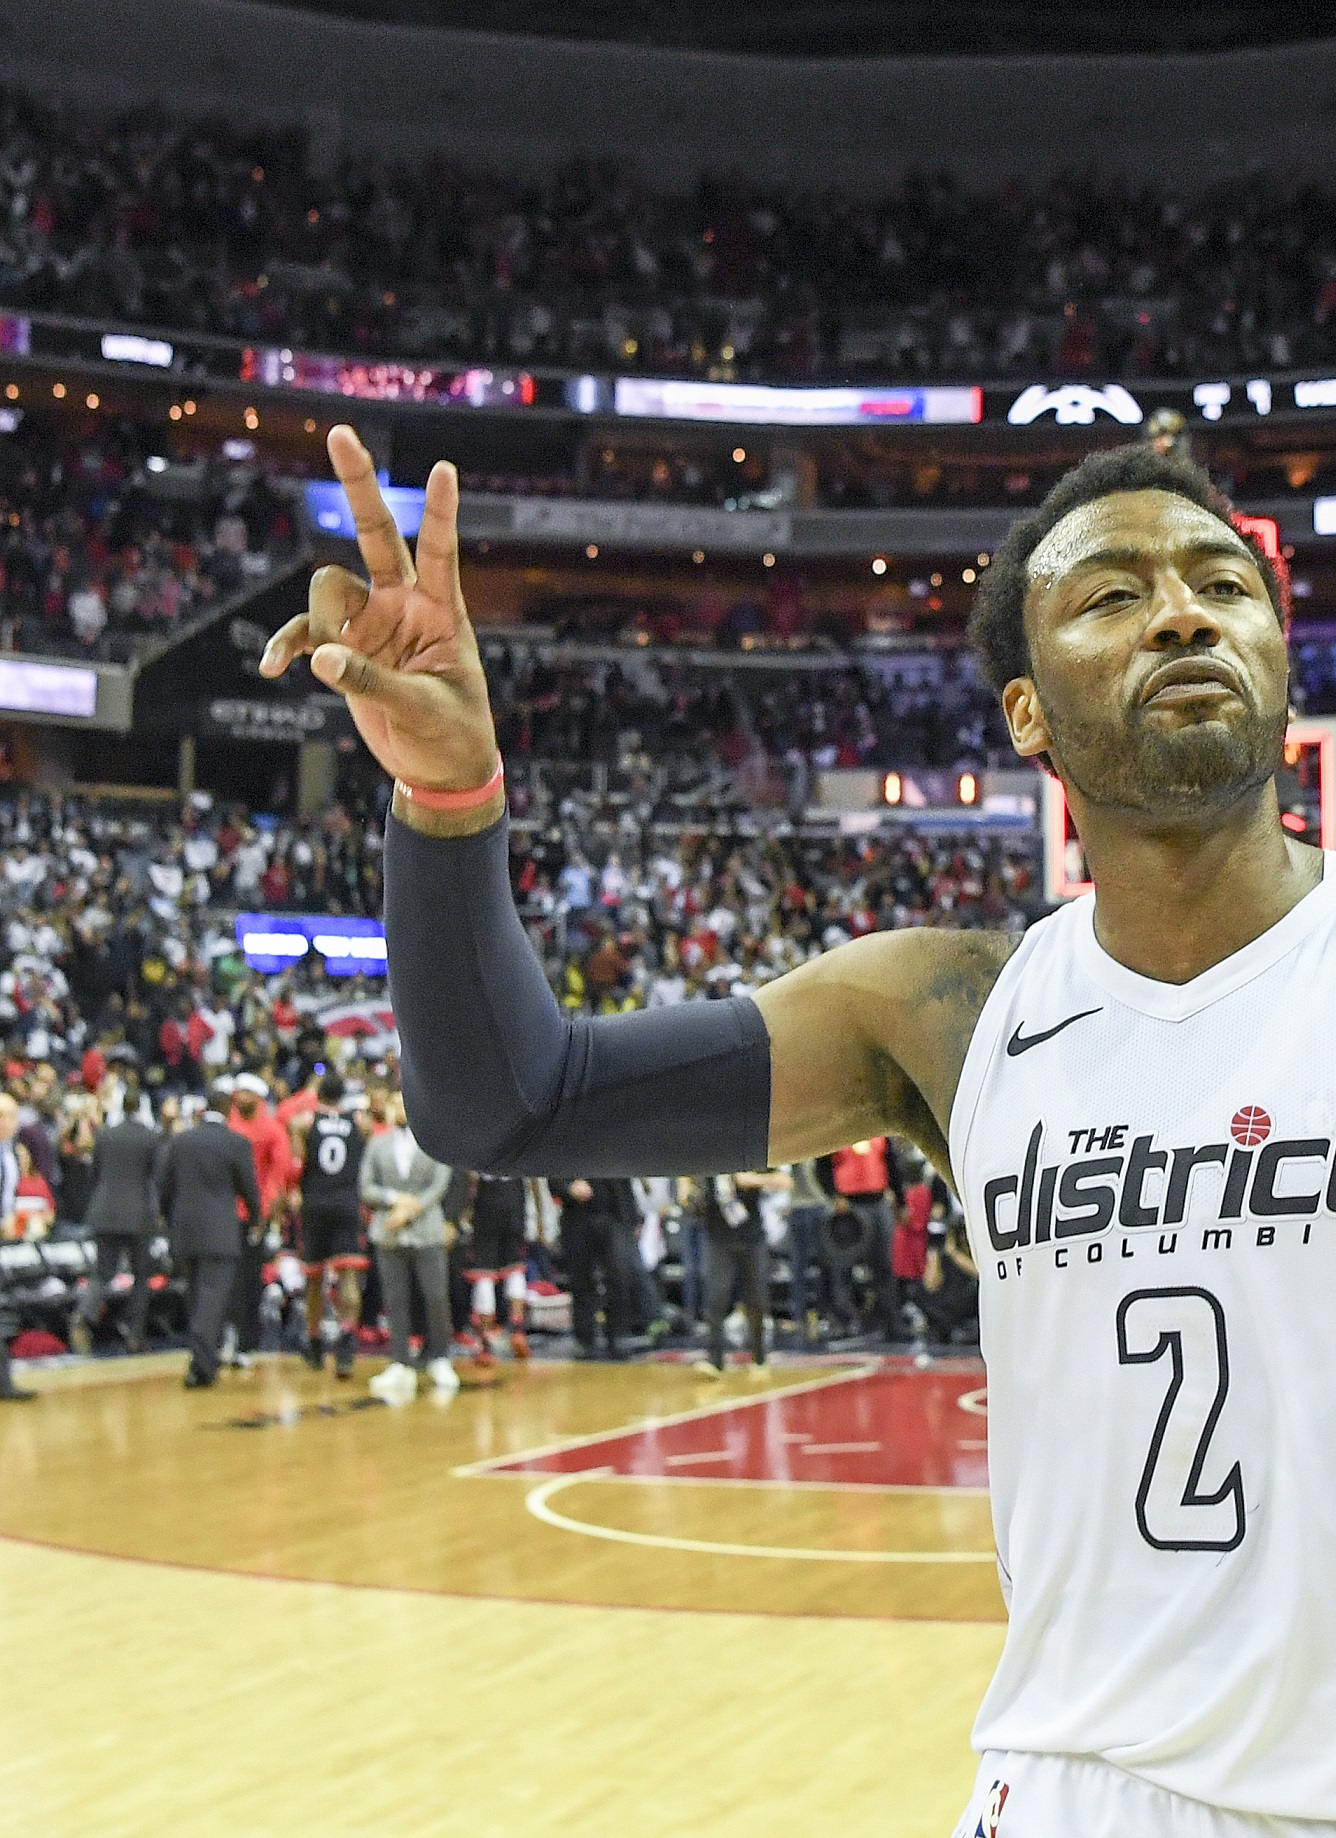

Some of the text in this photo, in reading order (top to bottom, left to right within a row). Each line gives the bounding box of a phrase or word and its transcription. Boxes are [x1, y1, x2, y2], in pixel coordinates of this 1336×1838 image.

[317, 1135, 348, 1175] 0
[1068, 1124, 1129, 1155] THE
[996, 1257, 1023, 1281] OF
[1116, 1285, 1246, 1551] 2
